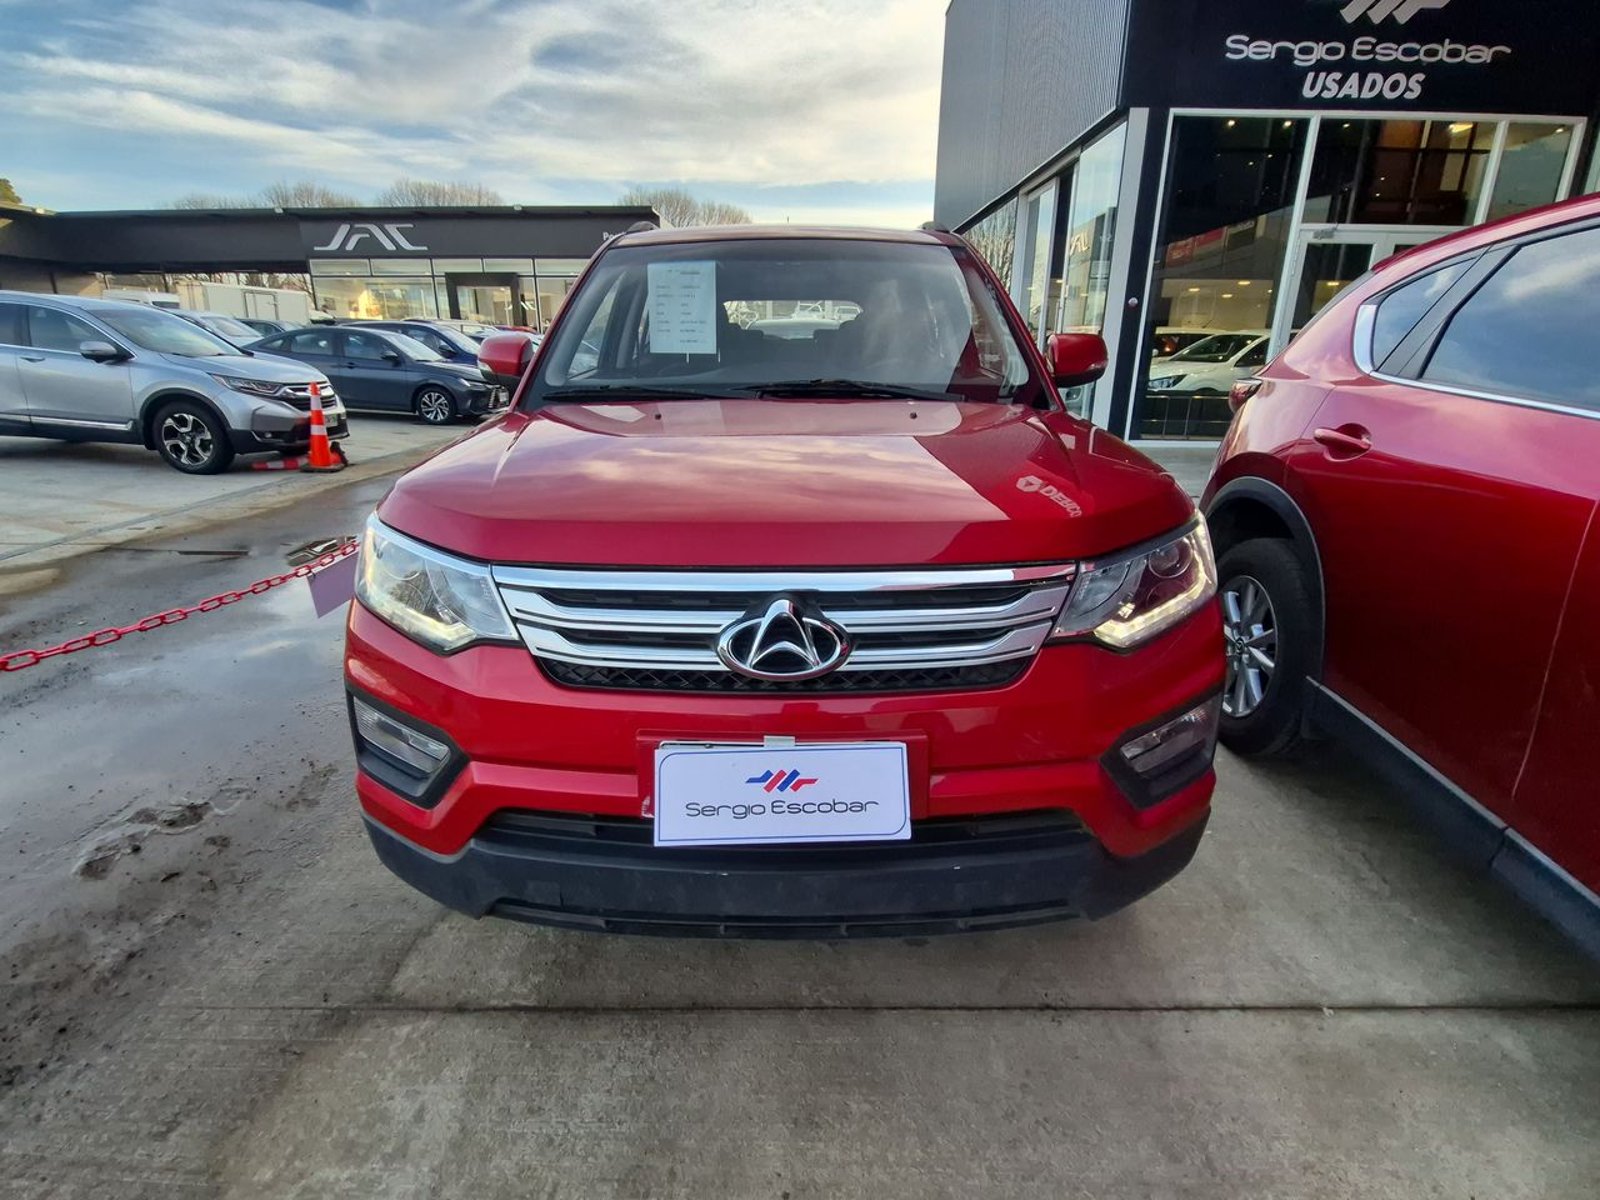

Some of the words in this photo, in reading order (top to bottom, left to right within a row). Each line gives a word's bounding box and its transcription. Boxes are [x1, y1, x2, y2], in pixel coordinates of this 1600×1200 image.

[1225, 34, 1346, 67] Sergio
[1351, 36, 1512, 64] Escobar
[1301, 71, 1426, 100] USADOS
[313, 223, 428, 251] JAC
[685, 802, 766, 820] Sergio
[770, 798, 880, 815] Escobar
